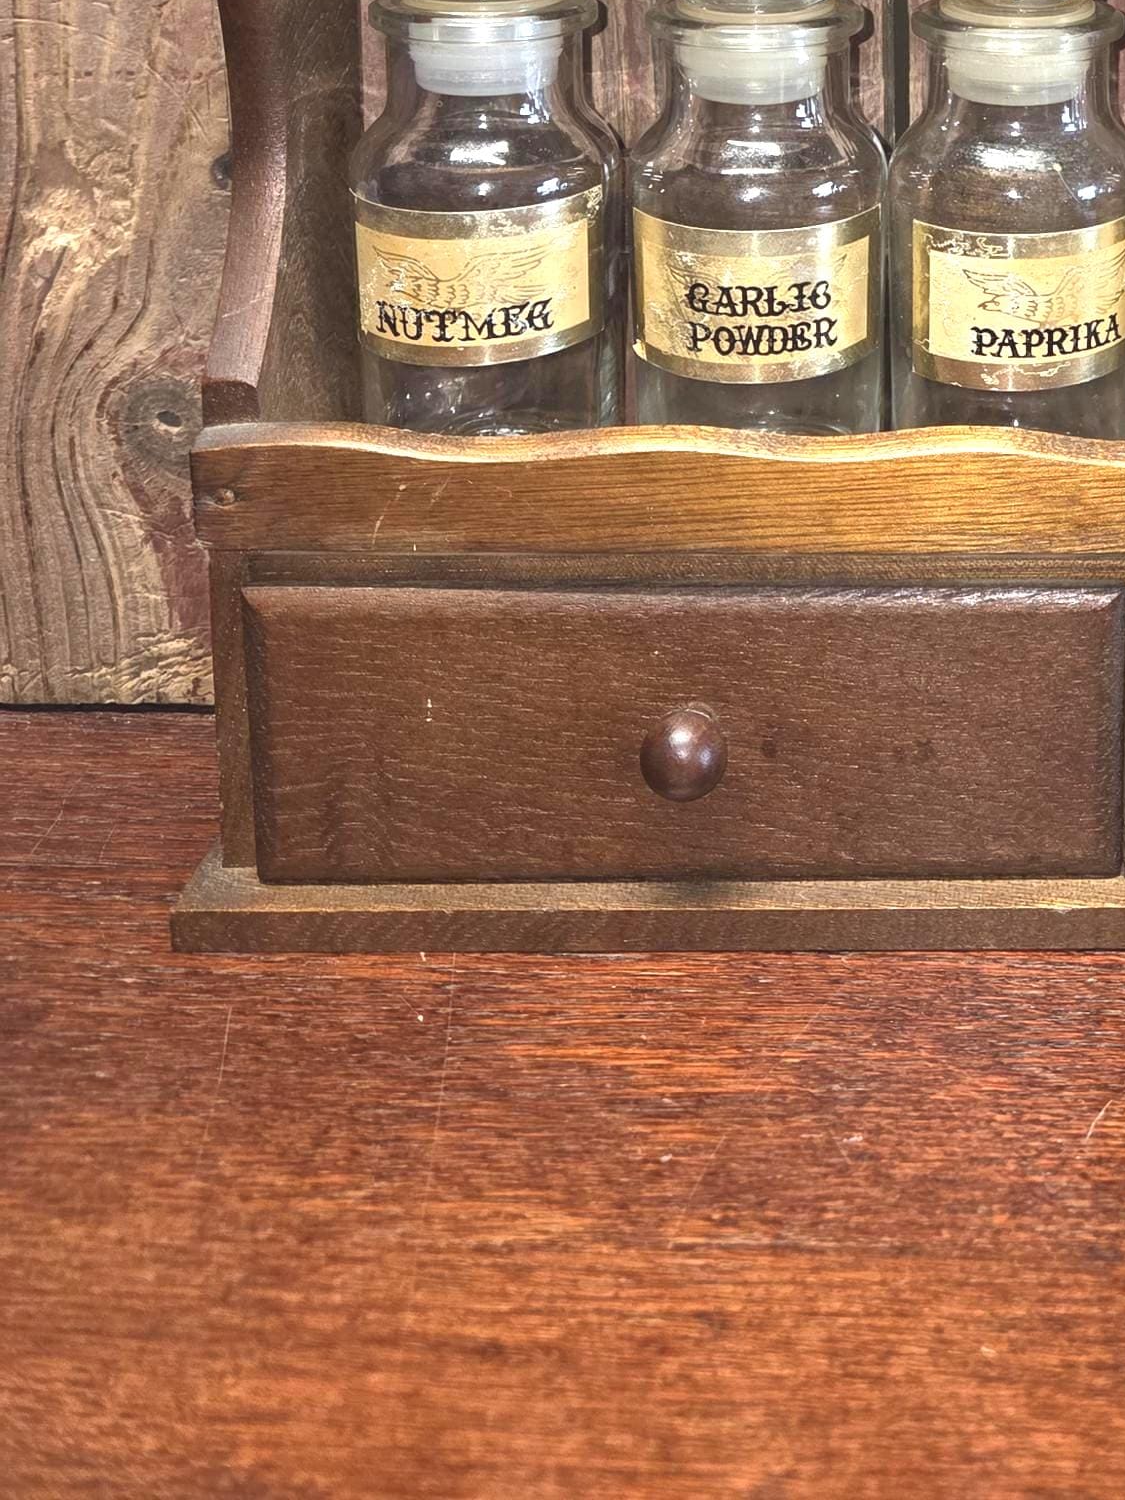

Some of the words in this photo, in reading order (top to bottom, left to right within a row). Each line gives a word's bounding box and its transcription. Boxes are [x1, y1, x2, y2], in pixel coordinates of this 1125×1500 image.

[376, 297, 554, 343] NUTMEG
[685, 280, 832, 318] GARLIC
[686, 317, 837, 356] POWDER
[971, 312, 1122, 359] PAPRIKA
